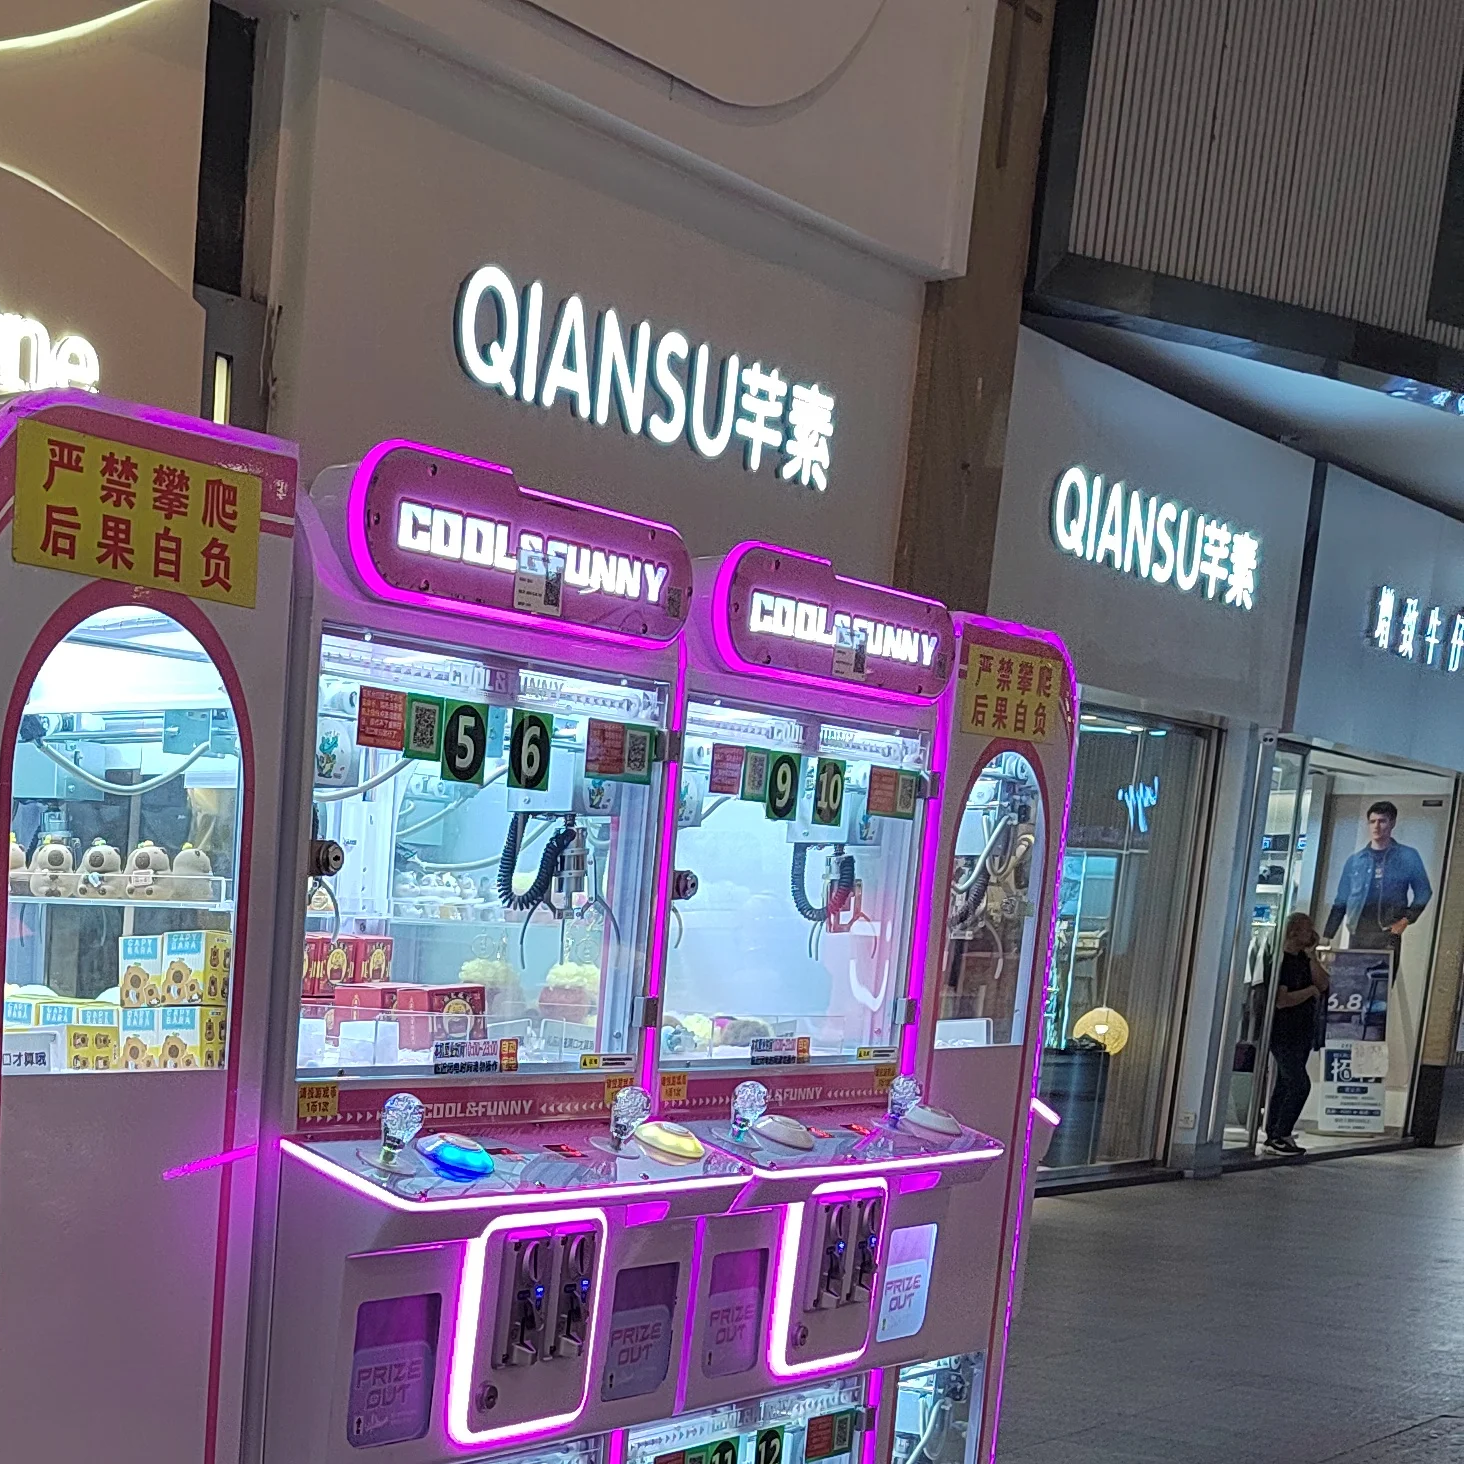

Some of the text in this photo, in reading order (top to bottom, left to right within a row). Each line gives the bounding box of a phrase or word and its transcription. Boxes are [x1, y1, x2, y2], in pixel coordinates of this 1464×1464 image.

[42, 438, 238, 534] 严禁攀爬
[40, 504, 233, 593] 后果自负
[976, 653, 1053, 698] 严禁攀爬
[971, 694, 1047, 737] 后果自负
[454, 714, 477, 769] 5
[521, 724, 542, 777] 6
[775, 763, 793, 798] 9
[817, 767, 844, 811] 10
[424, 1099, 533, 1119] COOL&FUNNY
[885, 1274, 922, 1296] PRIZE
[710, 1304, 755, 1328] PRIZE
[888, 1293, 914, 1313] OUT
[611, 1322, 662, 1348] PRIZE
[618, 1343, 652, 1367] OUT
[356, 1360, 423, 1388] PRIZE
[365, 1384, 411, 1410] OUT
